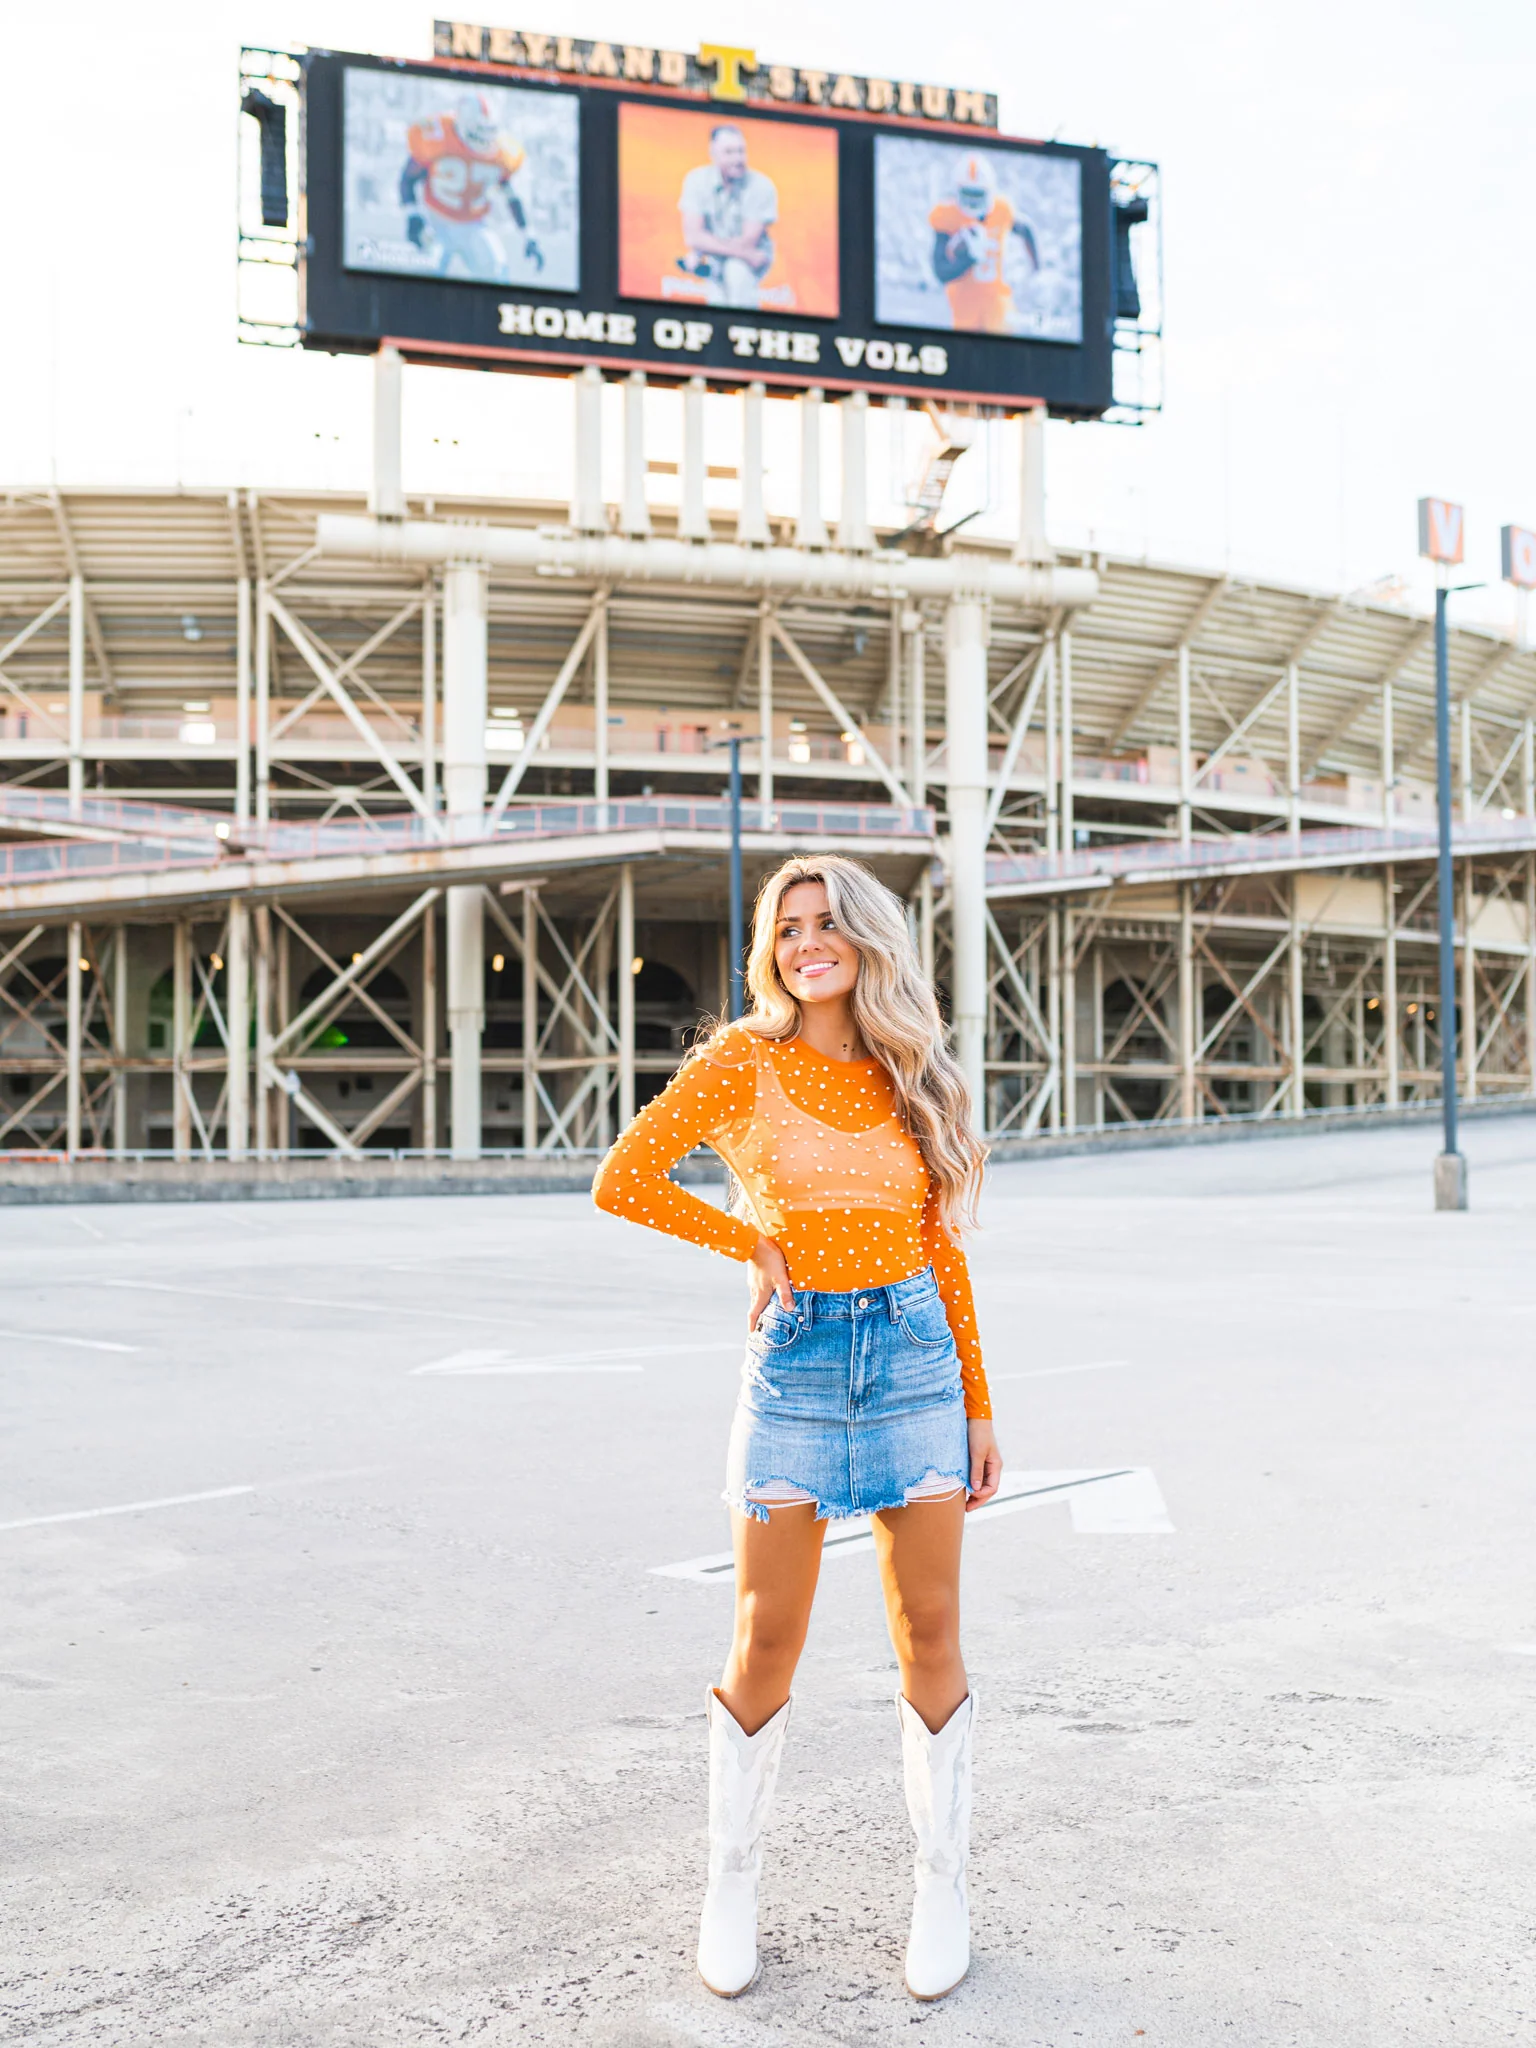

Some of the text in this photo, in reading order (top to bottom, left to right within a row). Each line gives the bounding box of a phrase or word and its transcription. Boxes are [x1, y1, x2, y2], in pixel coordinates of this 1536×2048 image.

[451, 23, 988, 122] NEYLAND T STADIUM
[499, 303, 948, 375] HOME OF THE VOLS
[1432, 501, 1462, 557] V
